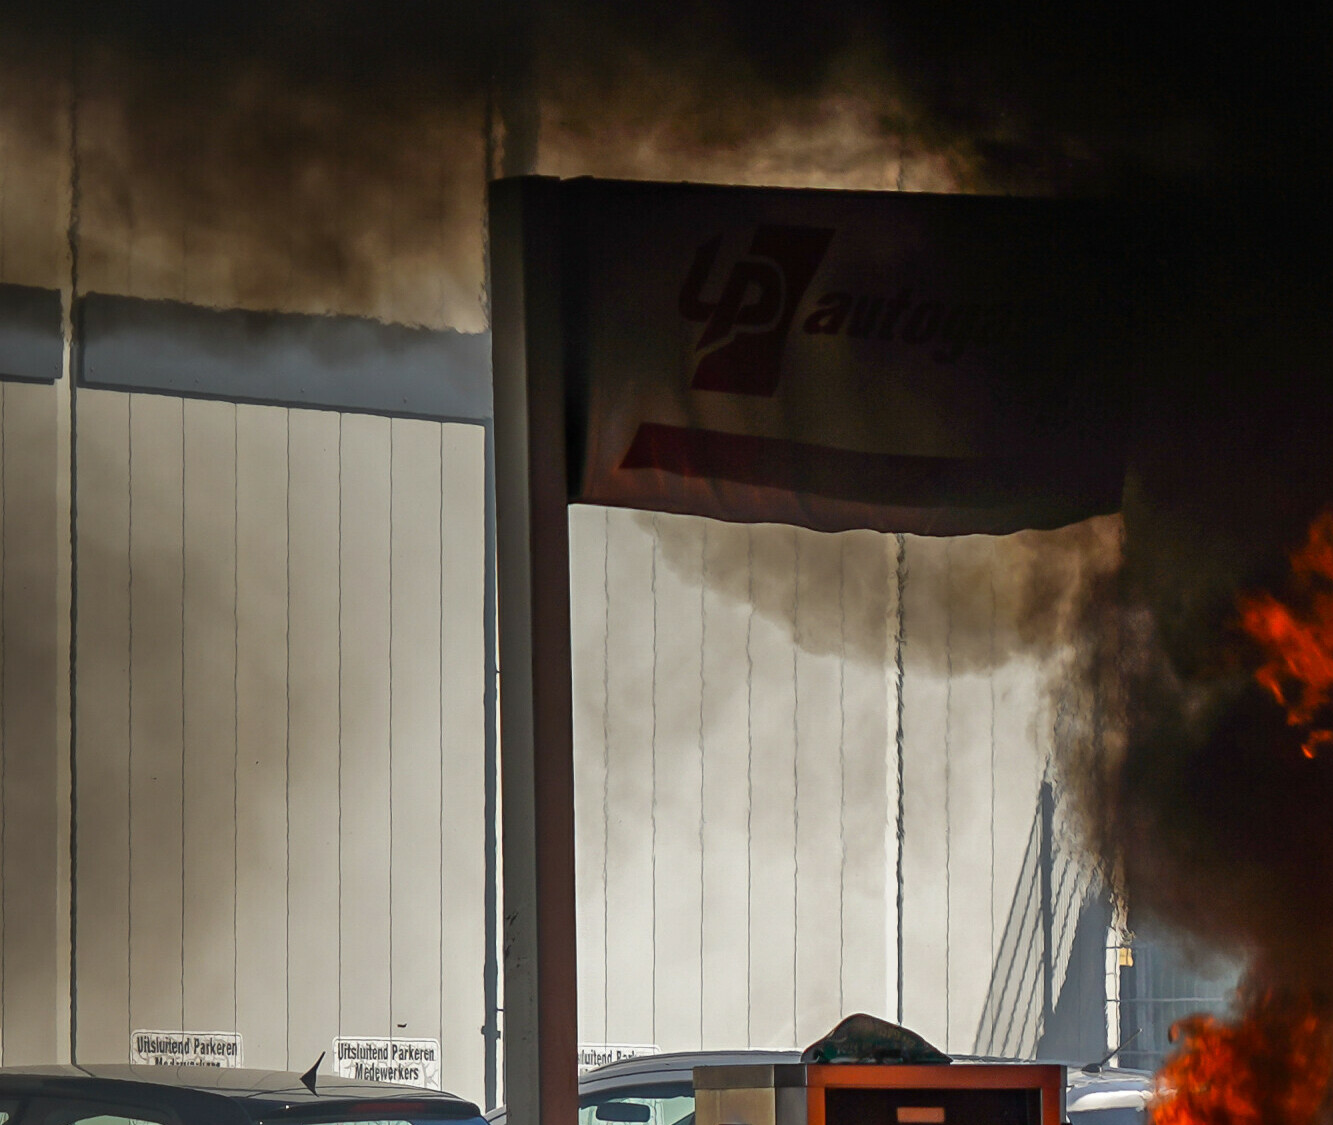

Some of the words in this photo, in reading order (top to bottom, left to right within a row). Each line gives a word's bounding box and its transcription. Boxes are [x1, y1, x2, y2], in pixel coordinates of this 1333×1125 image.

[137, 1036, 190, 1054] Uitsluitend
[194, 1038, 237, 1056] Parkeren
[338, 1043, 388, 1060] Uitsluitend
[392, 1044, 435, 1061] Parkeren
[355, 1062, 419, 1081] Medewerkers
